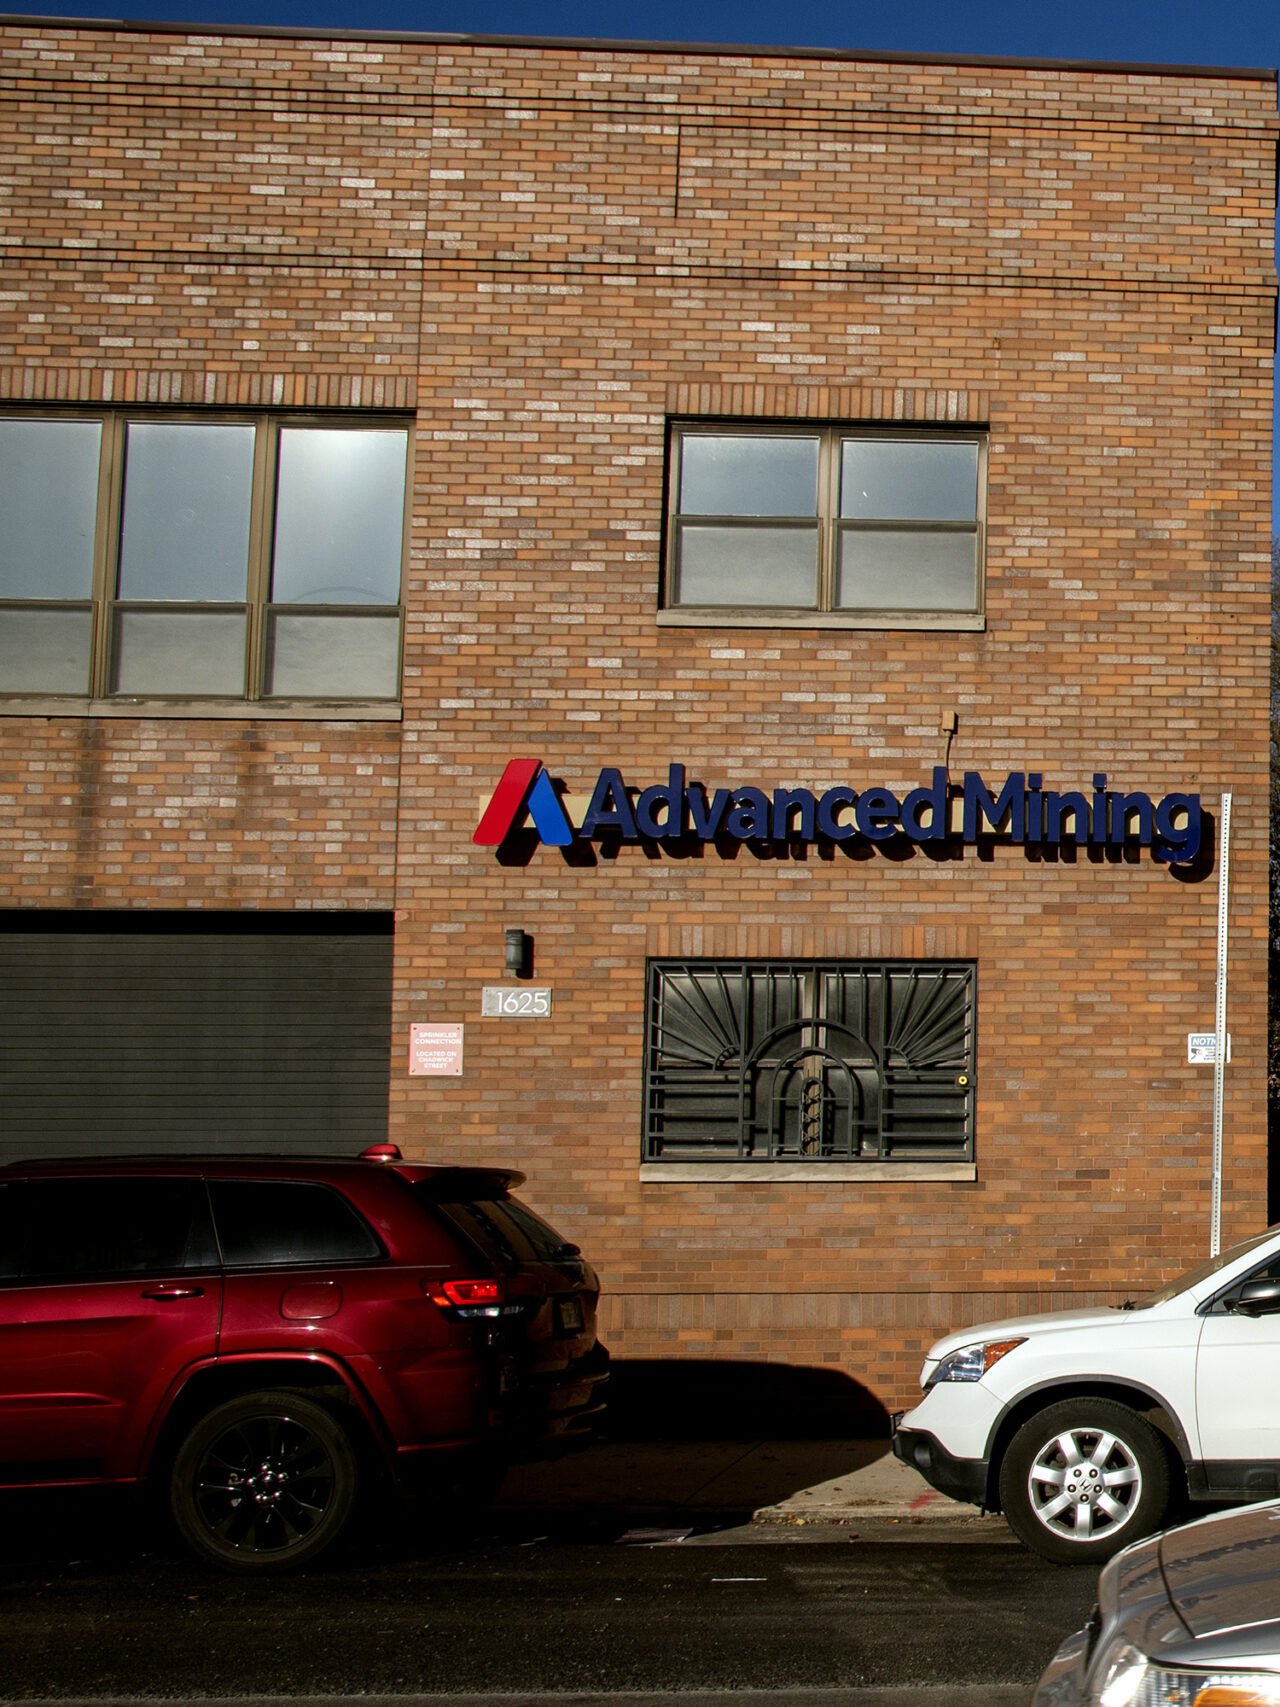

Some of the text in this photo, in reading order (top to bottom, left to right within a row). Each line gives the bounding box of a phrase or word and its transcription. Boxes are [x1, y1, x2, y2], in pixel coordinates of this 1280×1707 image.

[578, 763, 1201, 863] Advanced Mining
[497, 992, 548, 1013] 1625
[1192, 1037, 1216, 1046] NOTI
